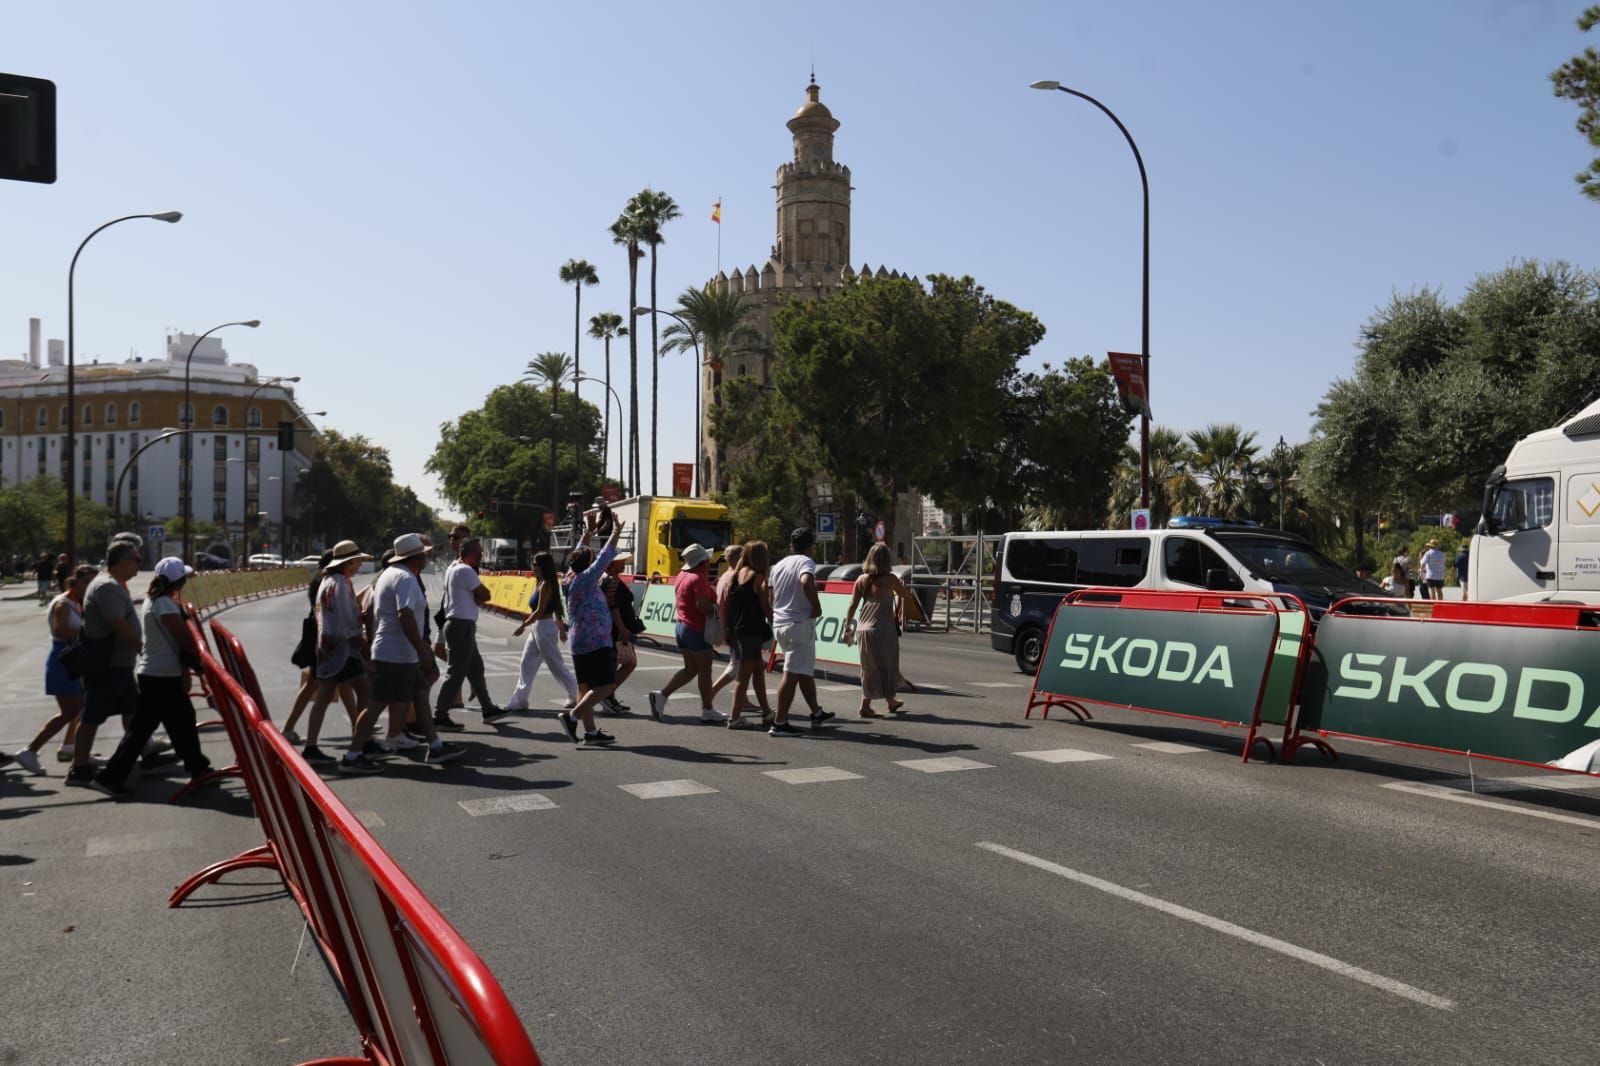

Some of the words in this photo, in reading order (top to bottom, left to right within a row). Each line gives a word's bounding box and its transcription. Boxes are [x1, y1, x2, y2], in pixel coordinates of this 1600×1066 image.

[820, 516, 831, 531] P
[1059, 633, 1234, 688] SKODA
[1333, 652, 1600, 728] SKOD
